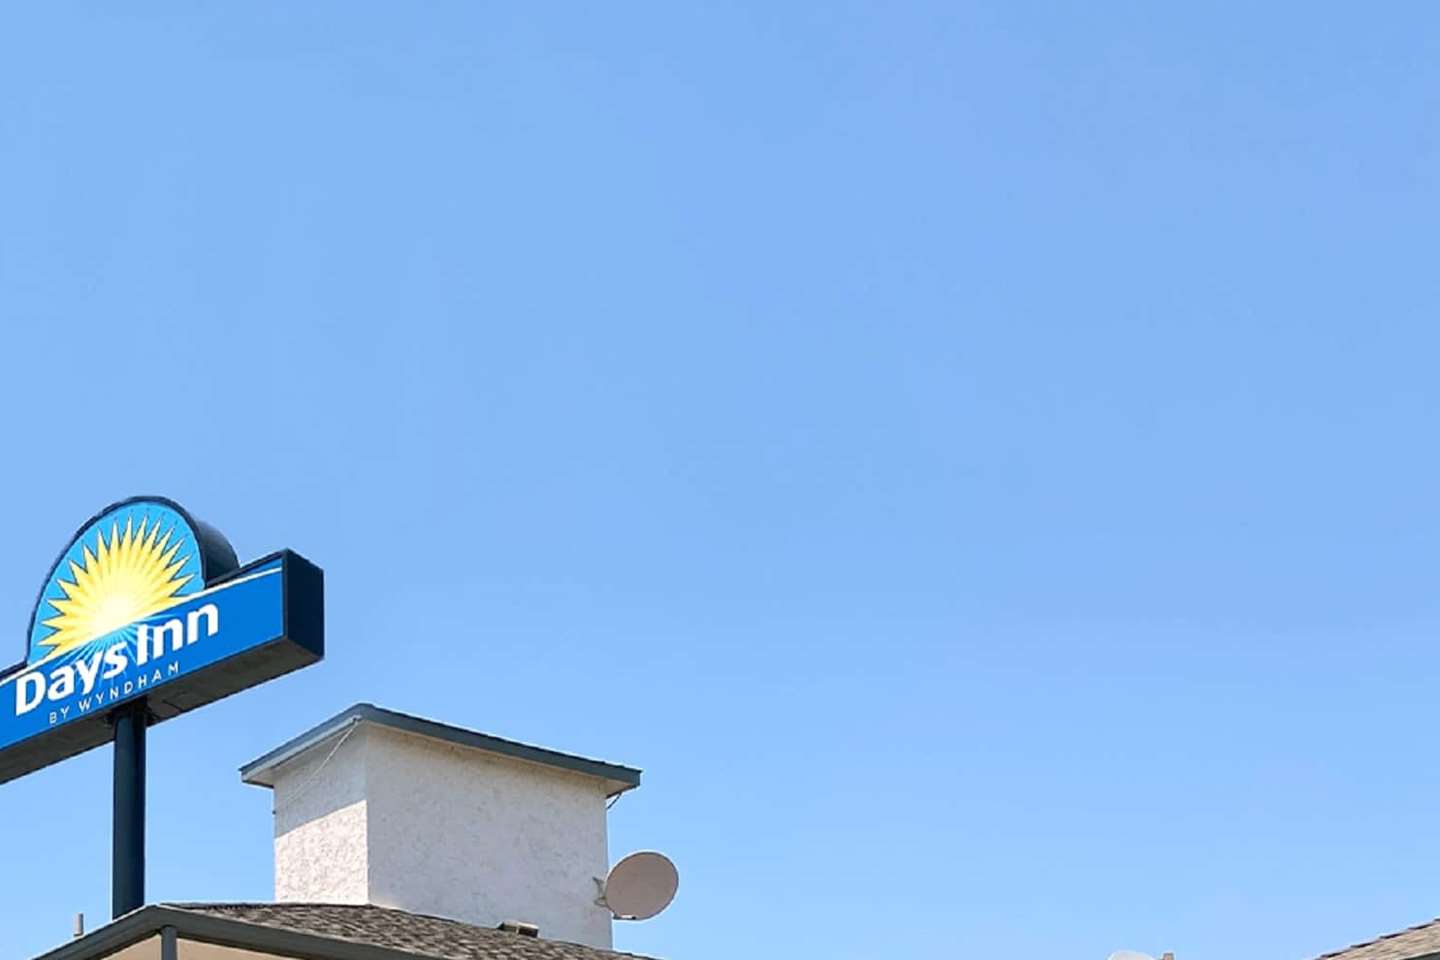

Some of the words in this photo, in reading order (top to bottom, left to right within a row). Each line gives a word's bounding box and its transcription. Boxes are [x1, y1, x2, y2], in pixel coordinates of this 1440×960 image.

[16, 640, 128, 716] Days
[137, 603, 219, 666] Inn
[50, 706, 70, 724] BY
[78, 661, 180, 711] WYNDHAM
